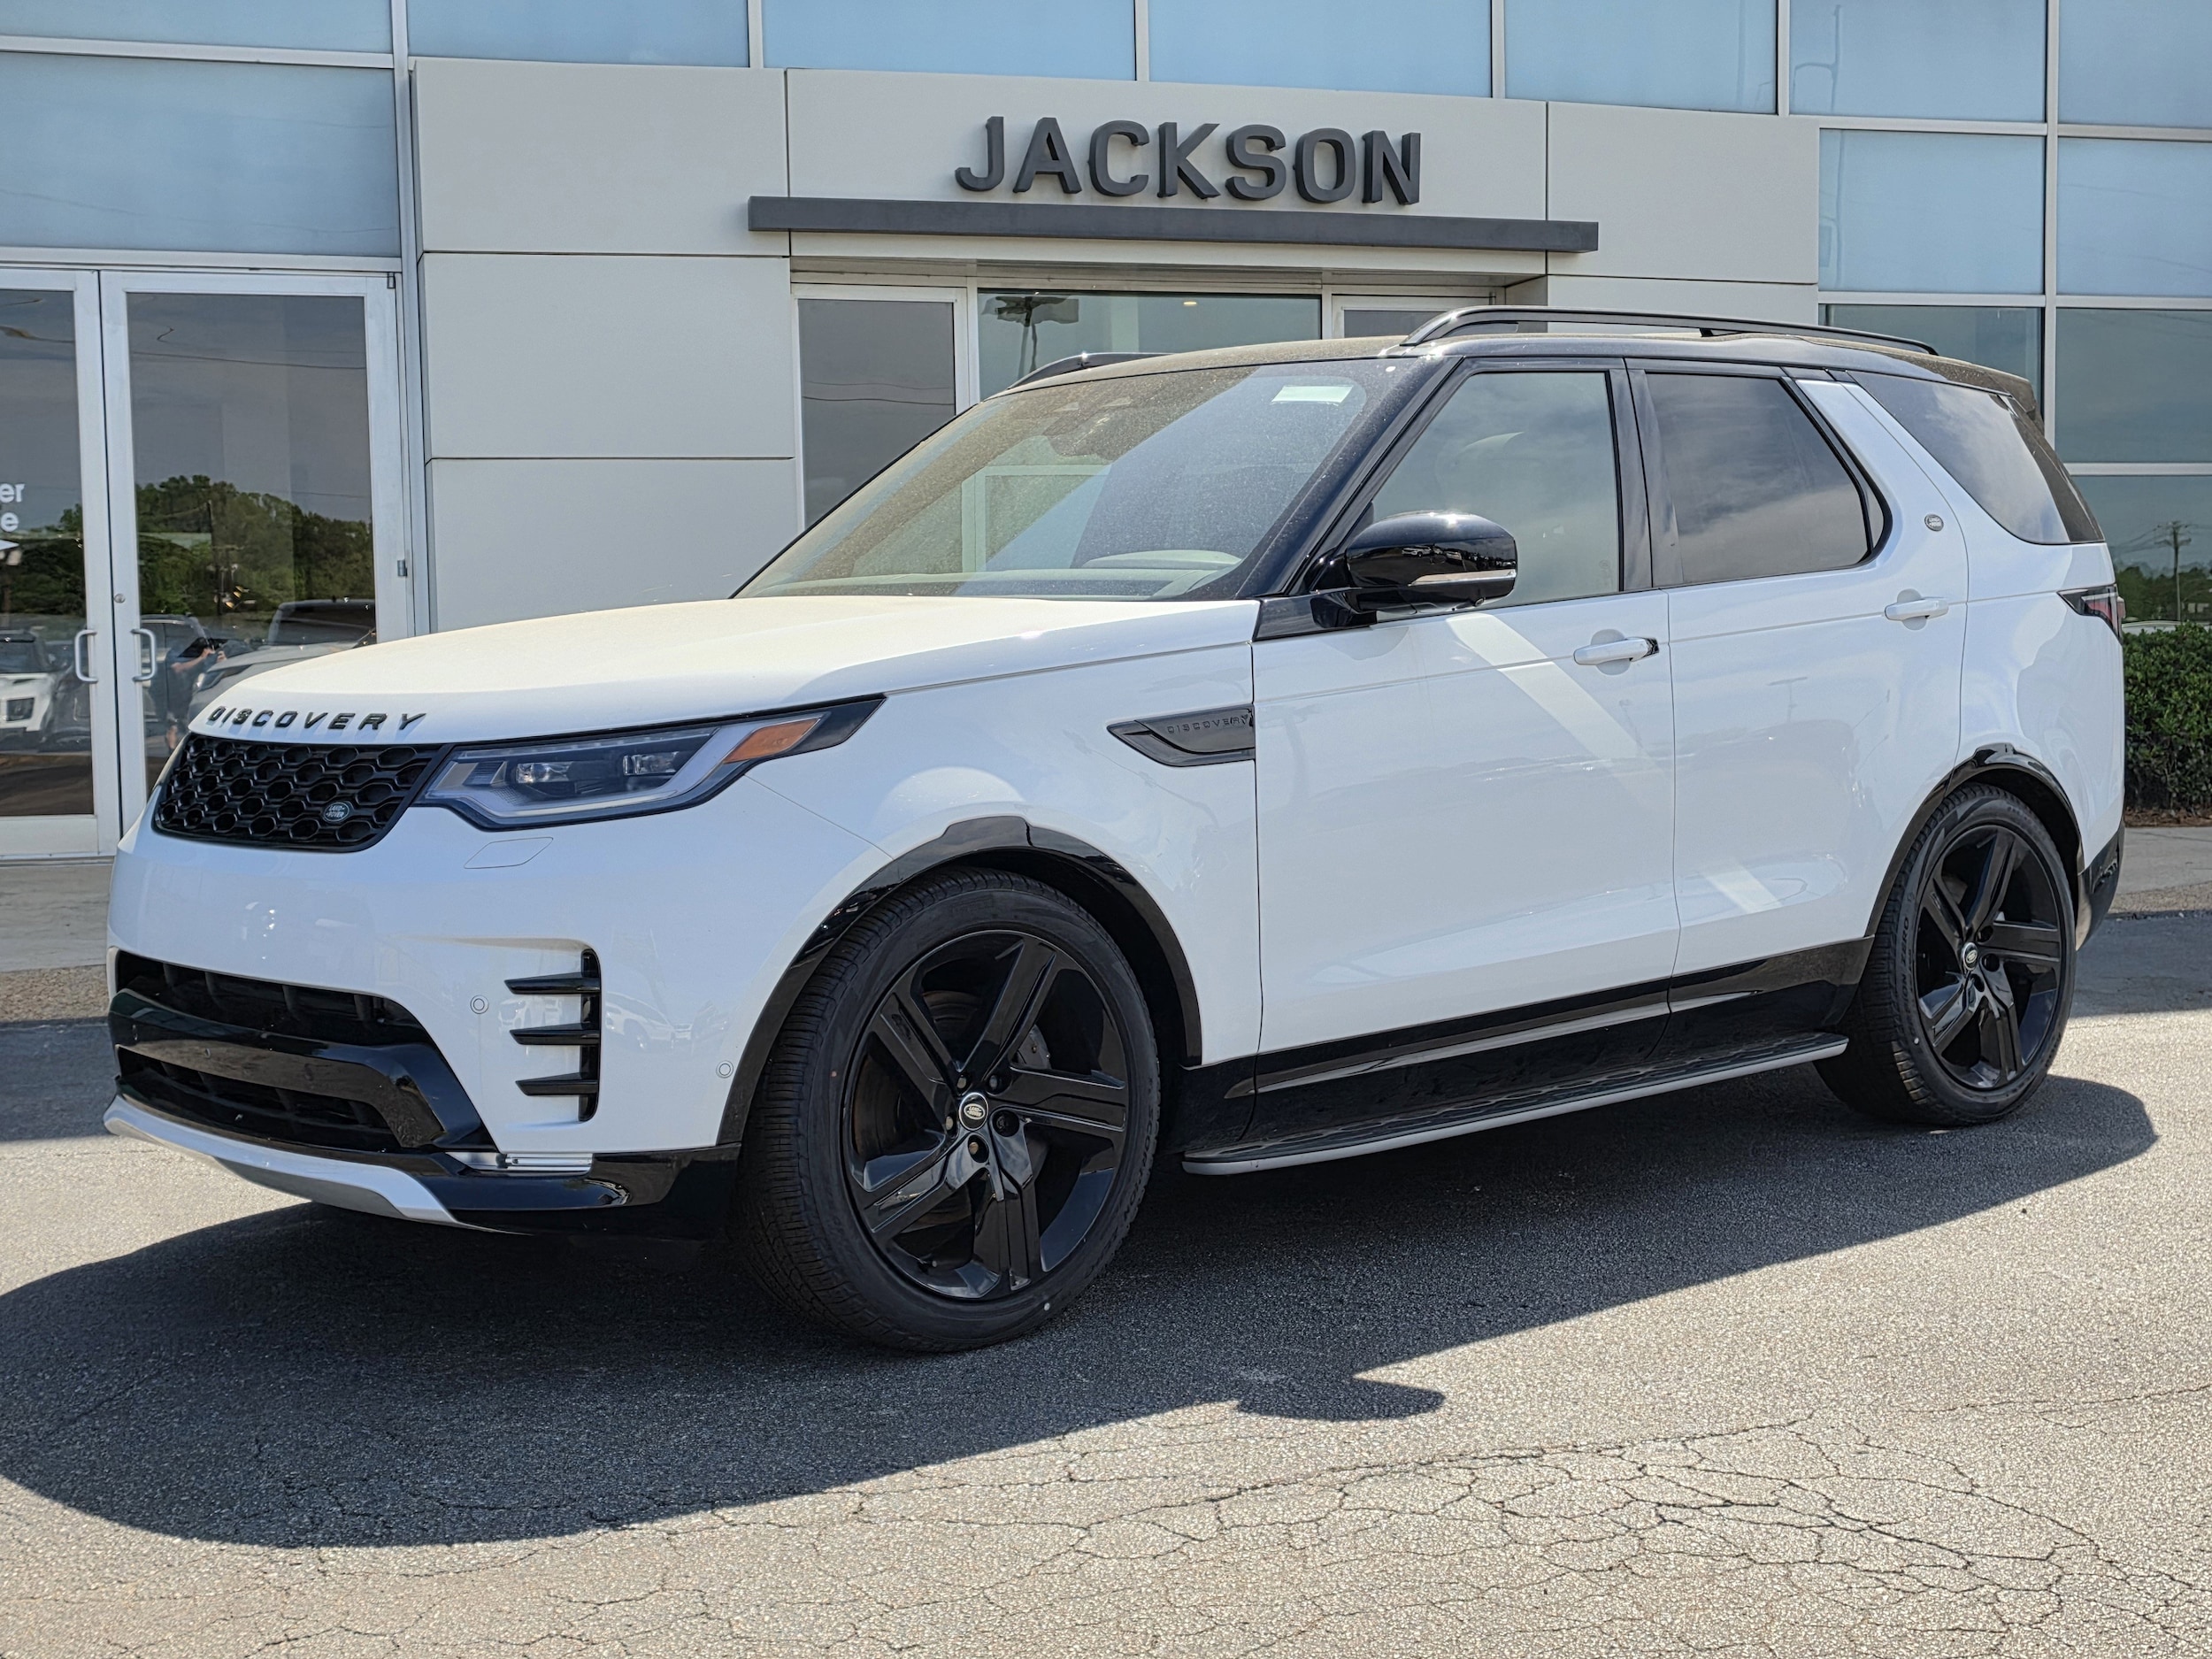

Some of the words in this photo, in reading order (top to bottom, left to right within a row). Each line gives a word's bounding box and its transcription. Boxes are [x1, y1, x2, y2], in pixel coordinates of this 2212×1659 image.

[955, 116, 1421, 205] JACKSON
[208, 706, 426, 731] DISCOVERY
[1167, 714, 1248, 734] DISCOVERY
